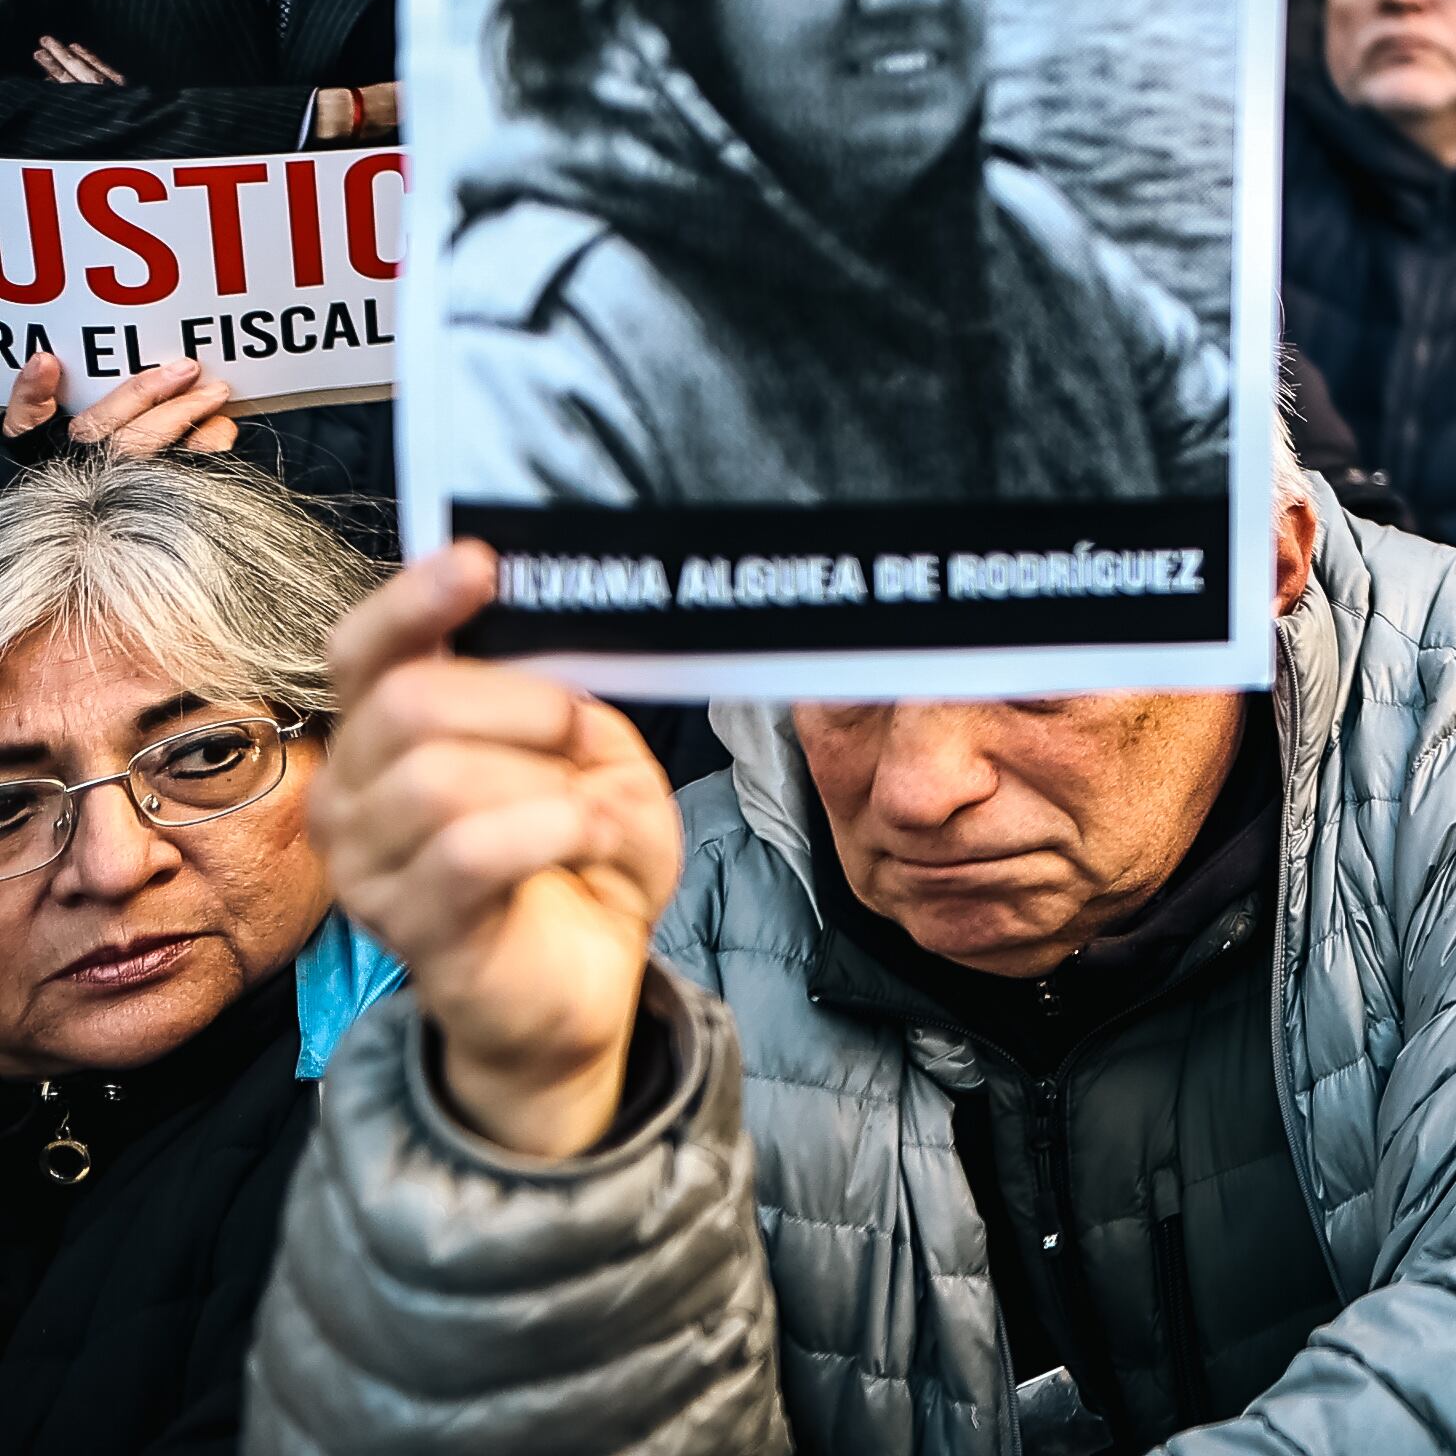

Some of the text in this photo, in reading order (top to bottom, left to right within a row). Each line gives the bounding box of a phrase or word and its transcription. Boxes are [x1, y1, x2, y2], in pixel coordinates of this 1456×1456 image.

[82, 324, 160, 377] EL
[181, 298, 395, 363] FISCAL
[498, 554, 672, 610] ILVANA
[875, 554, 940, 602] DE
[948, 541, 1204, 598] RODRÍGUEZ
